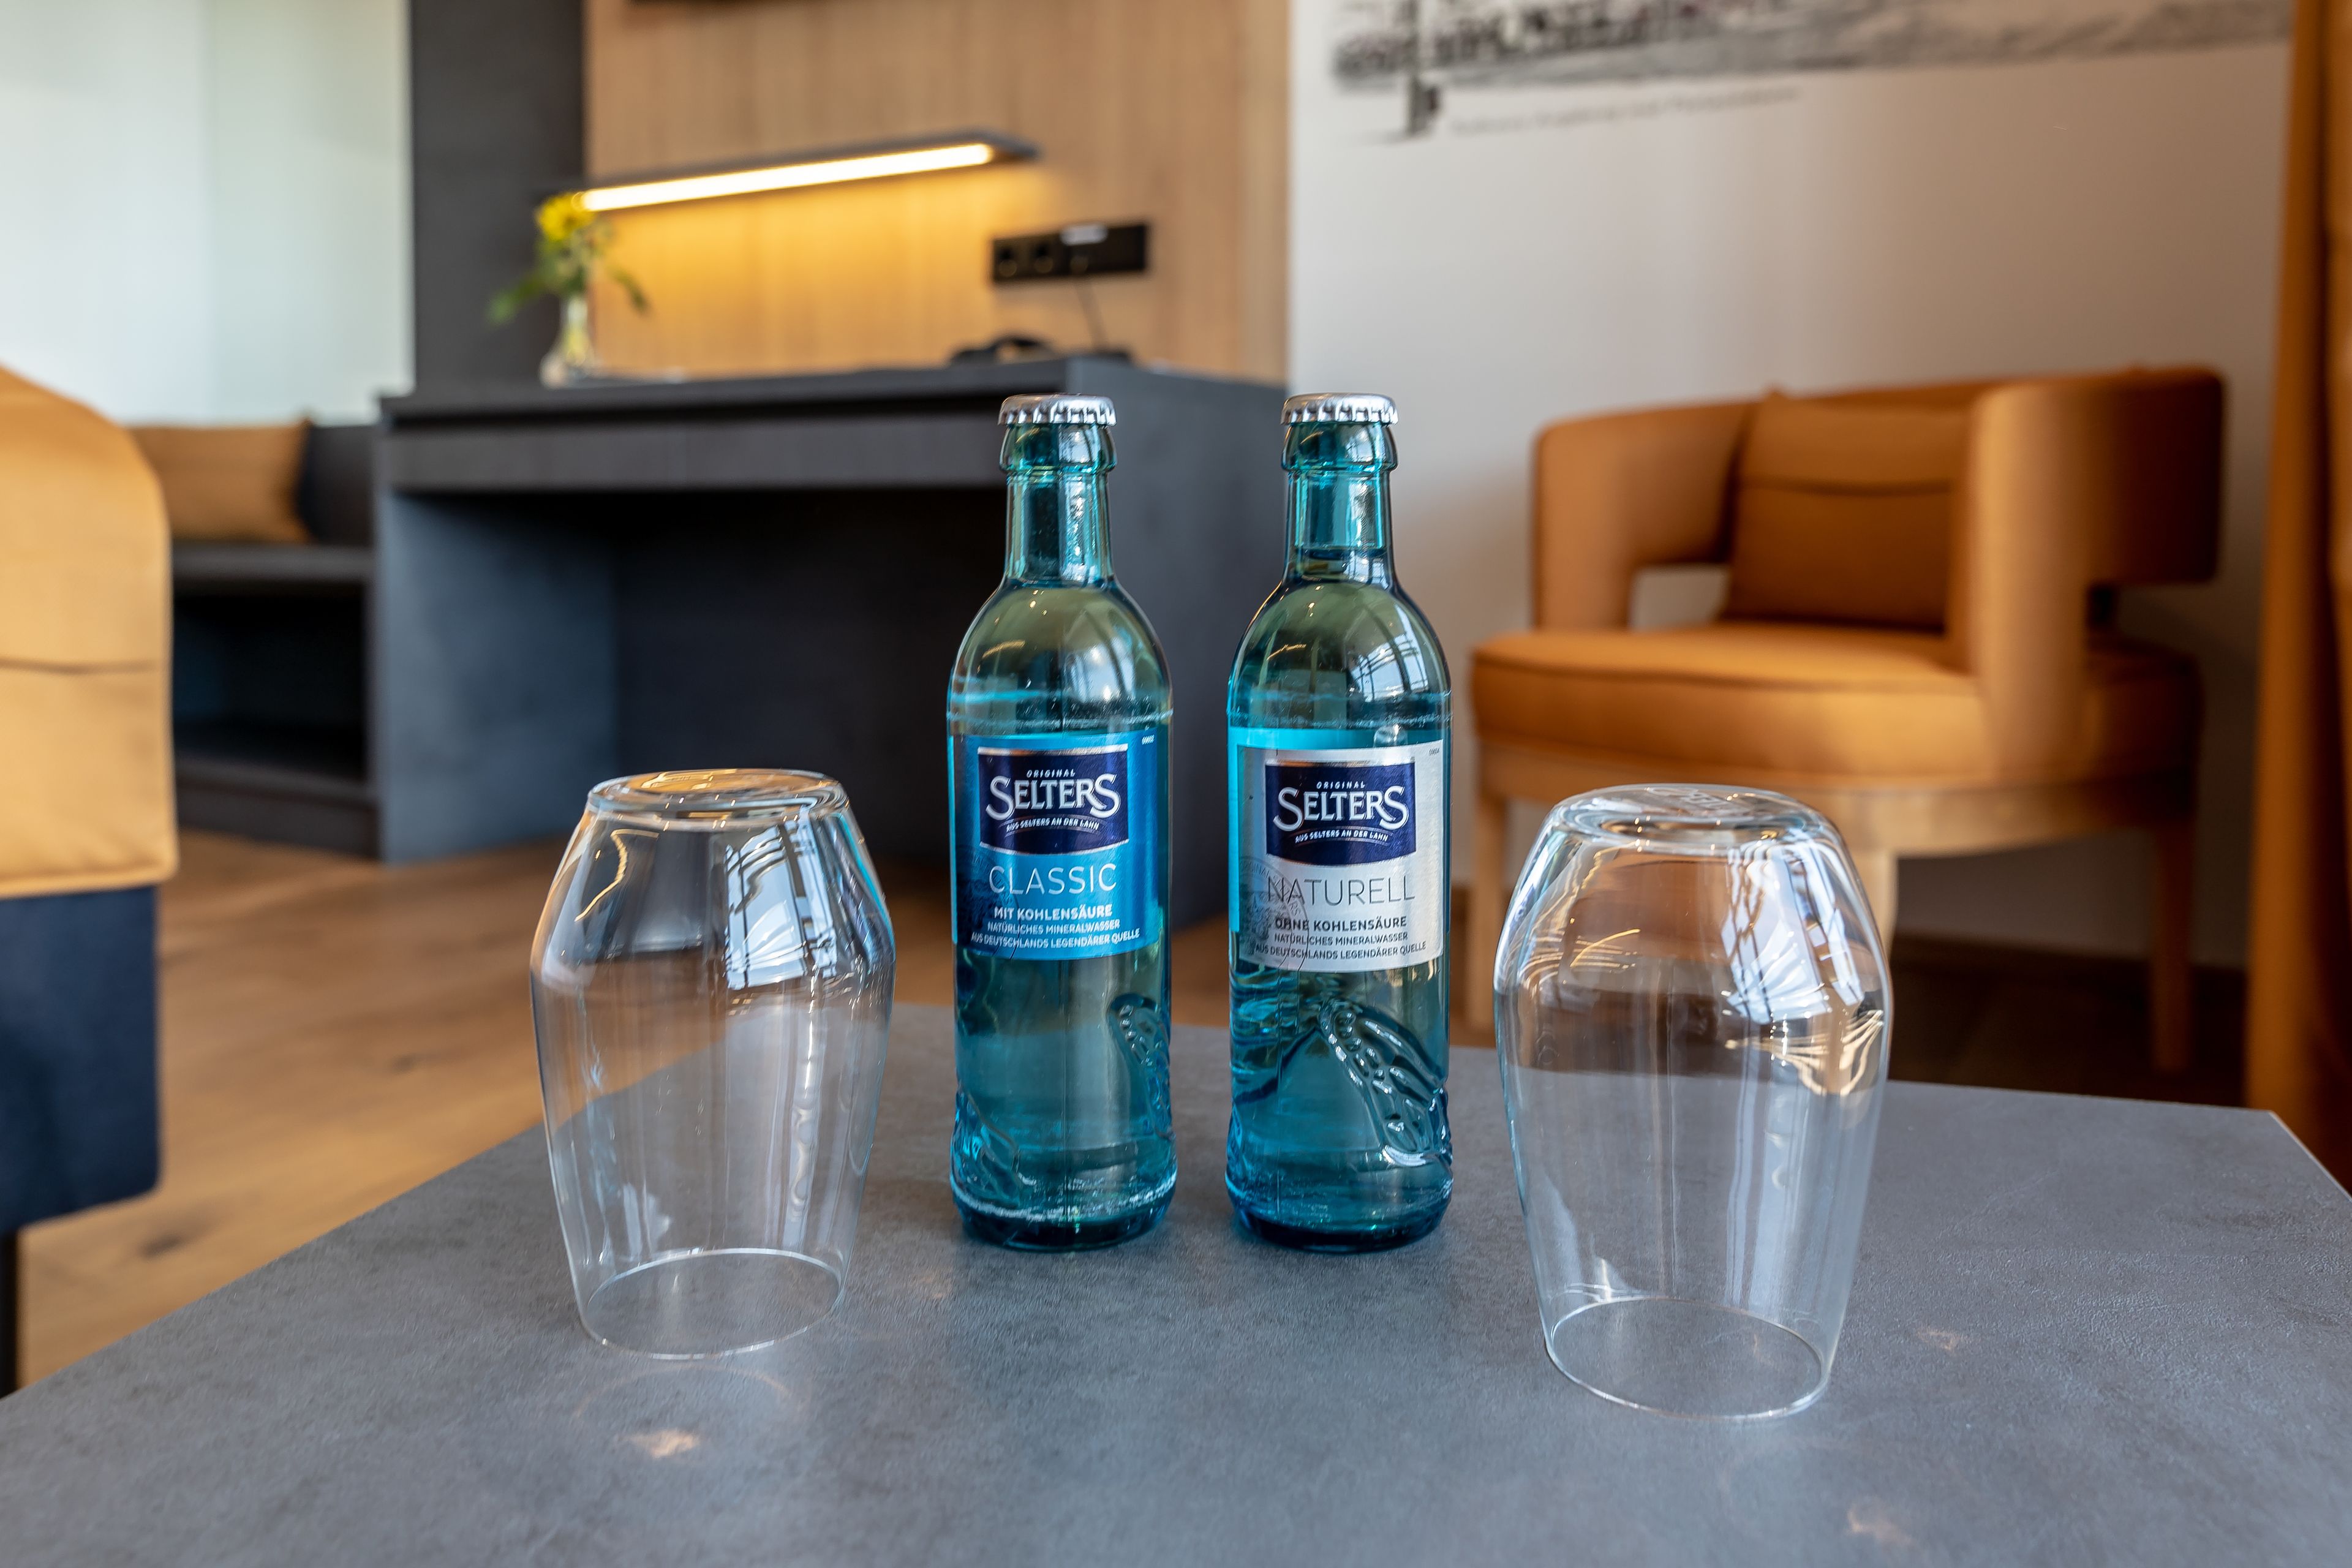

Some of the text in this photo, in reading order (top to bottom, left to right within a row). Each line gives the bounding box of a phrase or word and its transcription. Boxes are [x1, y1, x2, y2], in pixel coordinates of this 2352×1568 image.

[1026, 768, 1076, 778] ORIGINAL
[1316, 780, 1366, 790] ORIGINAL
[986, 773, 1120, 820] SELTERS
[1273, 785, 1409, 832] SELTERS
[1006, 823, 1020, 833] AUS
[1020, 818, 1050, 829] SELTERS
[1080, 821, 1100, 831] LAHN
[1295, 833, 1308, 843] AUS
[1309, 829, 1340, 840] SELTERS
[1353, 829, 1368, 838] DER
[1369, 832, 1389, 842] LAHN
[989, 864, 1117, 895] CLASSIC
[1267, 875, 1415, 907] NATURELL
[994, 903, 1113, 921] MIT KOHLENSÄURE
[987, 919, 1120, 935] NATÜRLICHES MINERALWASSER
[1275, 916, 1407, 932] OHNE KOHLENSÄURE
[971, 928, 1140, 949] AUS DEUTSCHLANDS LEGENDÄRER QUELLE
[1274, 931, 1408, 946] NATÜRLICHES MINERALWASSER
[1256, 941, 1426, 960] AUS DEUTSCHLANDS LEGENDÄRER QUELLE
